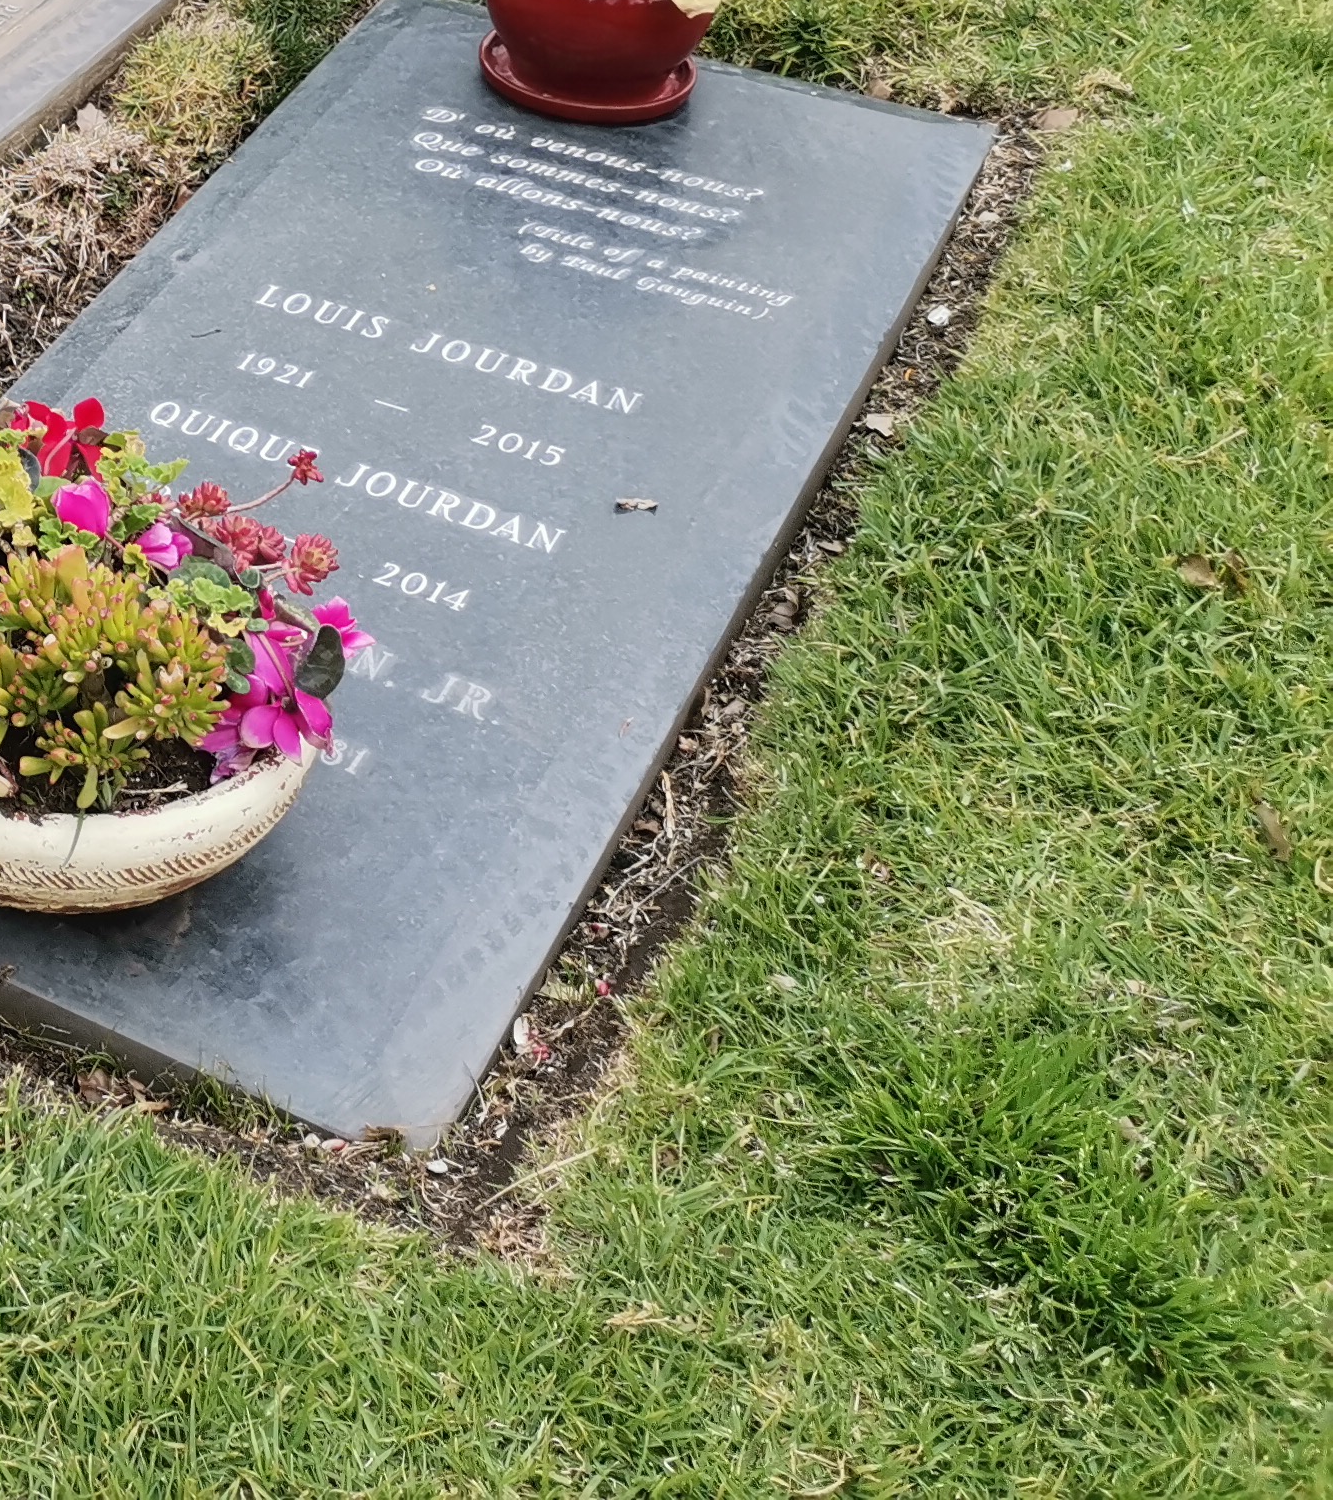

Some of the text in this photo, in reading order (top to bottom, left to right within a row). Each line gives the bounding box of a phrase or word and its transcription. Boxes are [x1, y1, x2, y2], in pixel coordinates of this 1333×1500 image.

[413, 132, 740, 223] Que sommes-nous?
[475, 176, 702, 240] allons-nous?
[518, 221, 793, 306] (Title of a painting
[519, 243, 554, 263] by
[561, 255, 631, 280] Paul
[255, 284, 643, 414] LOUIS JOURDAN
[237, 352, 317, 389] 1921
[471, 424, 567, 466] 2015
[335, 463, 566, 554] JOURDAN
[372, 562, 470, 612] 2014
[320, 738, 370, 776] 81
